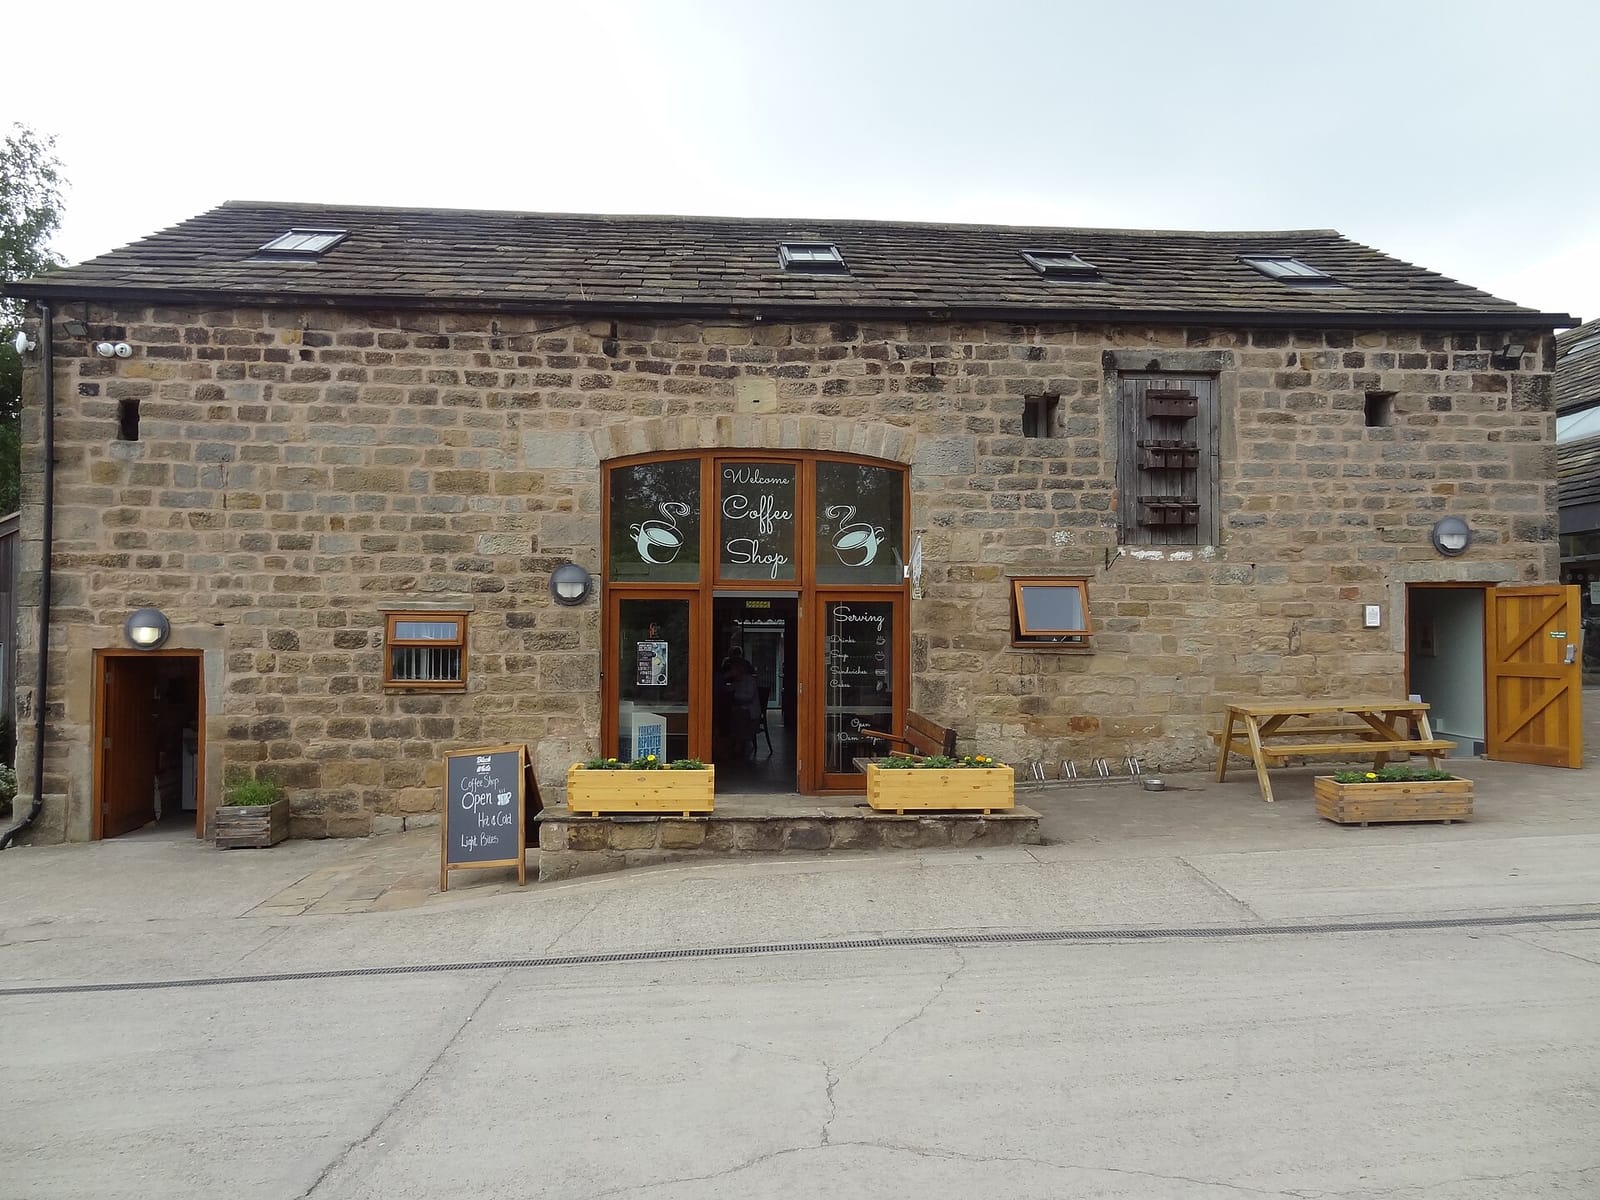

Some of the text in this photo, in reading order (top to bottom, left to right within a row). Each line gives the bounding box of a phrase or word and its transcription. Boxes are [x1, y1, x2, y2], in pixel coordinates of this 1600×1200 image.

[724, 468, 790, 485] Welcome
[722, 494, 792, 534] Coffee
[726, 538, 788, 580] Shop
[833, 606, 885, 631] Serving
[830, 635, 856, 644] Drinks
[830, 649, 849, 662] Soup
[830, 666, 868, 675] Sandwiches
[830, 679, 851, 687] Cakes
[638, 724, 661, 736] YORKSHIRE
[851, 718, 871, 732] Open
[638, 735, 661, 749] REPORTER
[638, 748, 661, 758] FREE
[461, 775, 500, 792] Coffee Shop
[461, 791, 492, 813] Open
[478, 812, 489, 828] Hot
[497, 811, 512, 827] Cold
[461, 832, 499, 851] Light Bites
